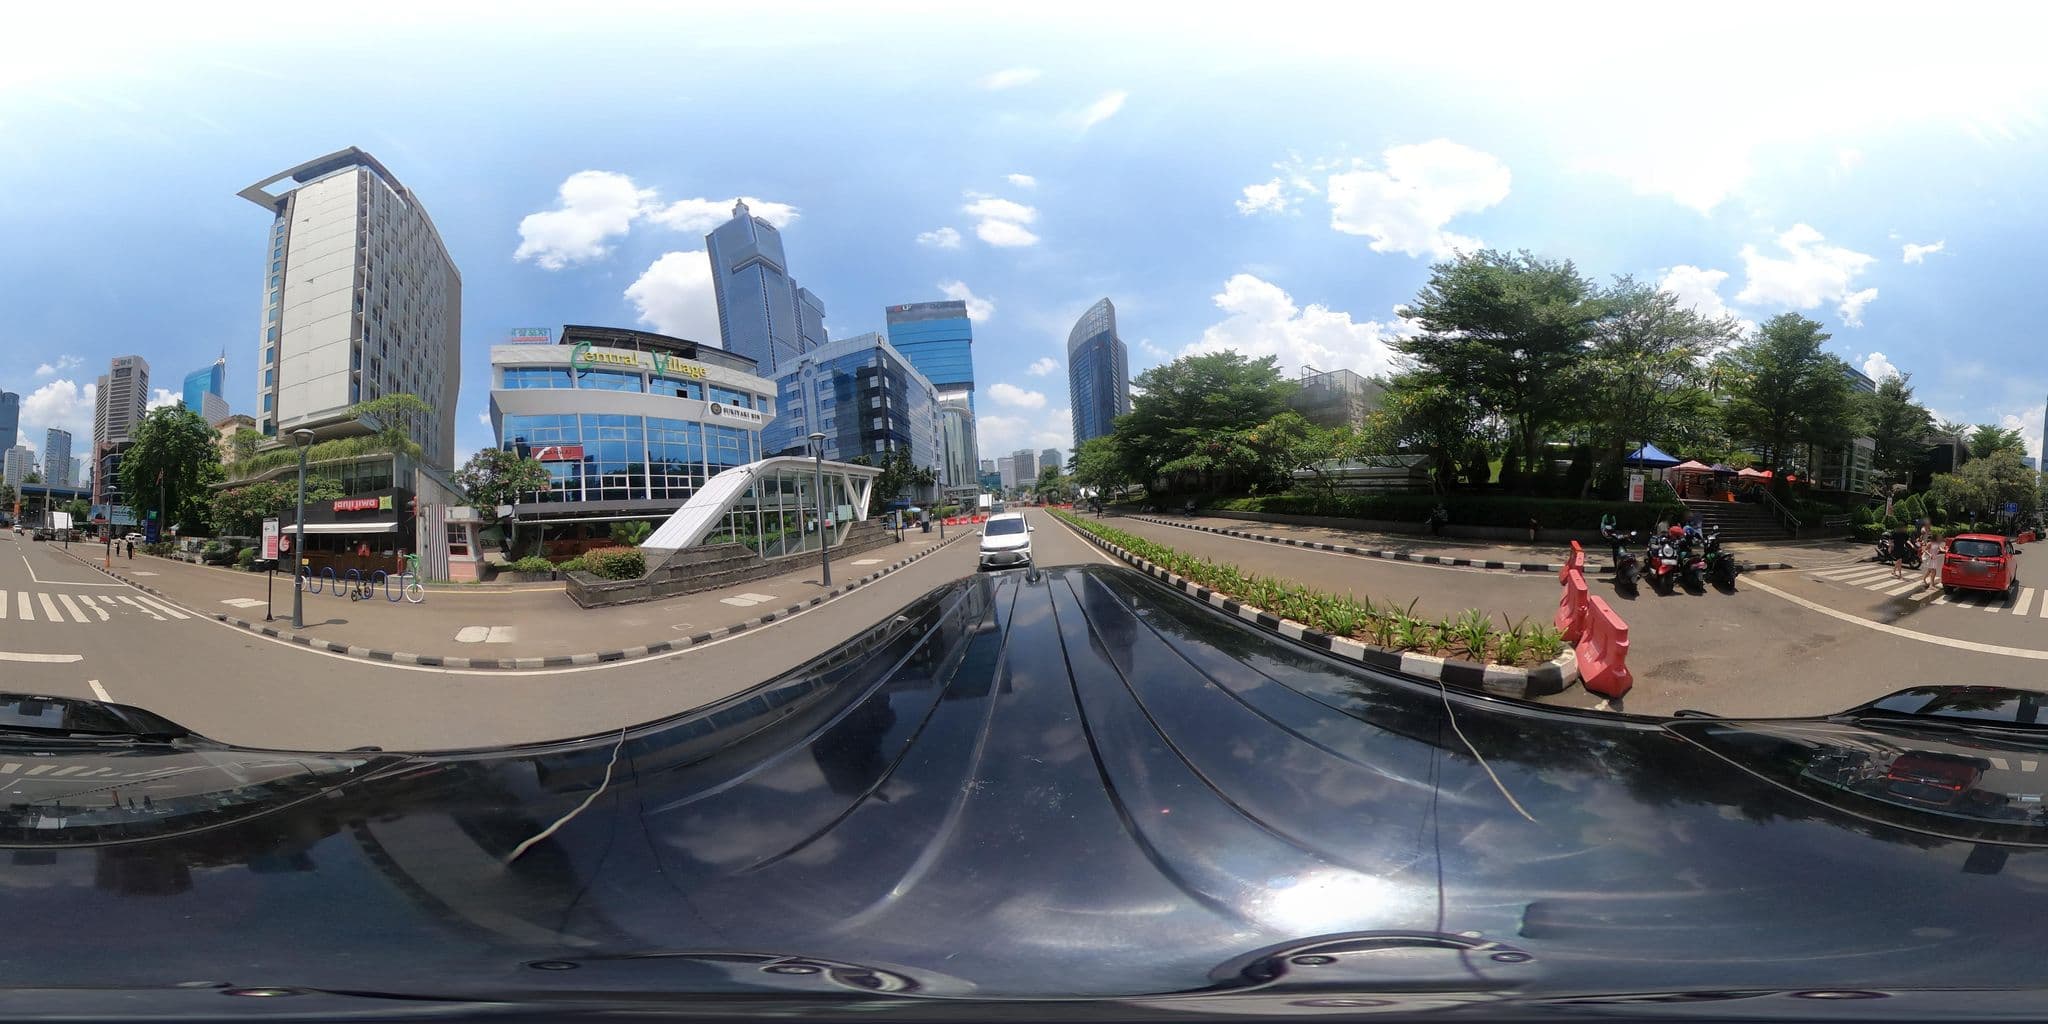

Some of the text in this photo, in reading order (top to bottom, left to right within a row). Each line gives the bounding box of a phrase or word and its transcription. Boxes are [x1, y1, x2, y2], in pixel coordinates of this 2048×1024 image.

[571, 341, 708, 378] Central Village
[333, 499, 375, 511] janji jiwa
